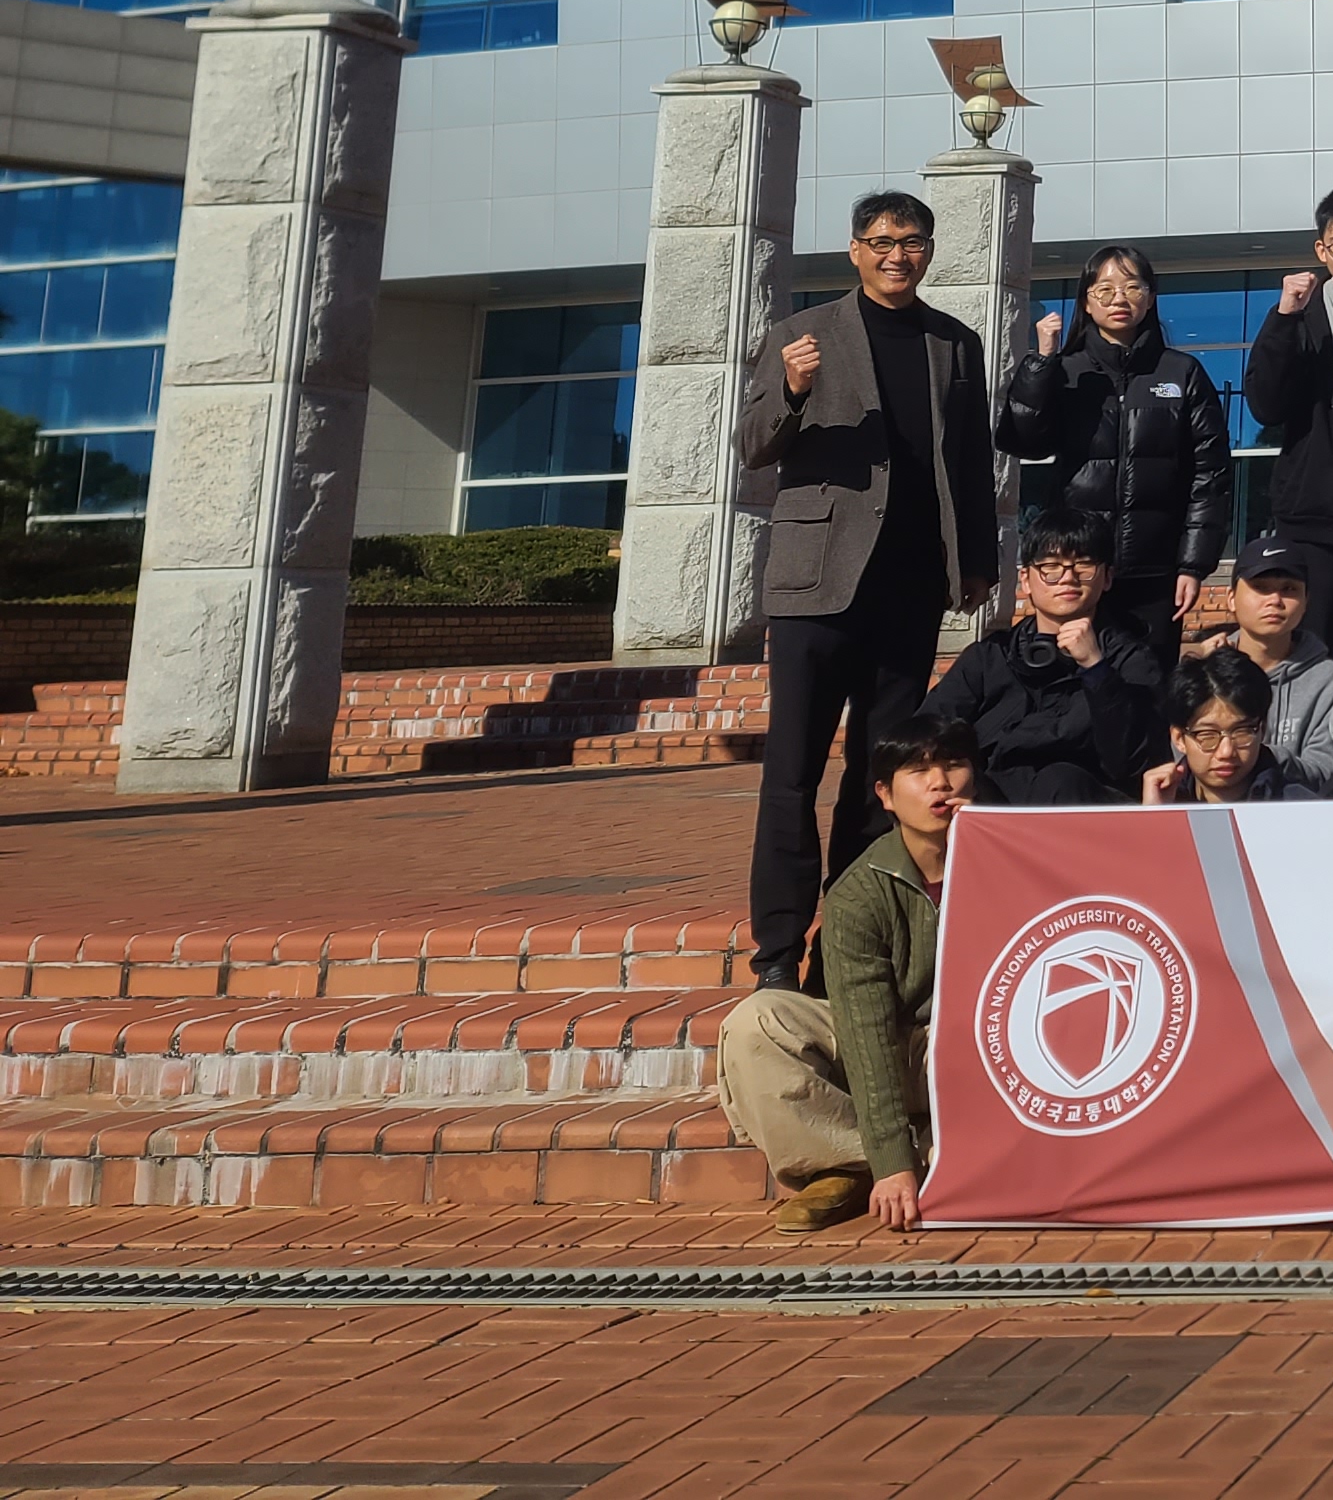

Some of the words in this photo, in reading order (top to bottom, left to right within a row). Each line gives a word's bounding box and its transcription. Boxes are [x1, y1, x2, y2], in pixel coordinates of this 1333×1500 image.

[1042, 909, 1126, 938] UNIVERSITY
[1127, 918, 1146, 934] OF
[991, 936, 1043, 1008] NATIONAL
[1146, 931, 1185, 1063] TRANSPORTATION
[986, 1011, 1005, 1064] KOREA
[1004, 1071, 1157, 1124] 국립한국교통대학교
